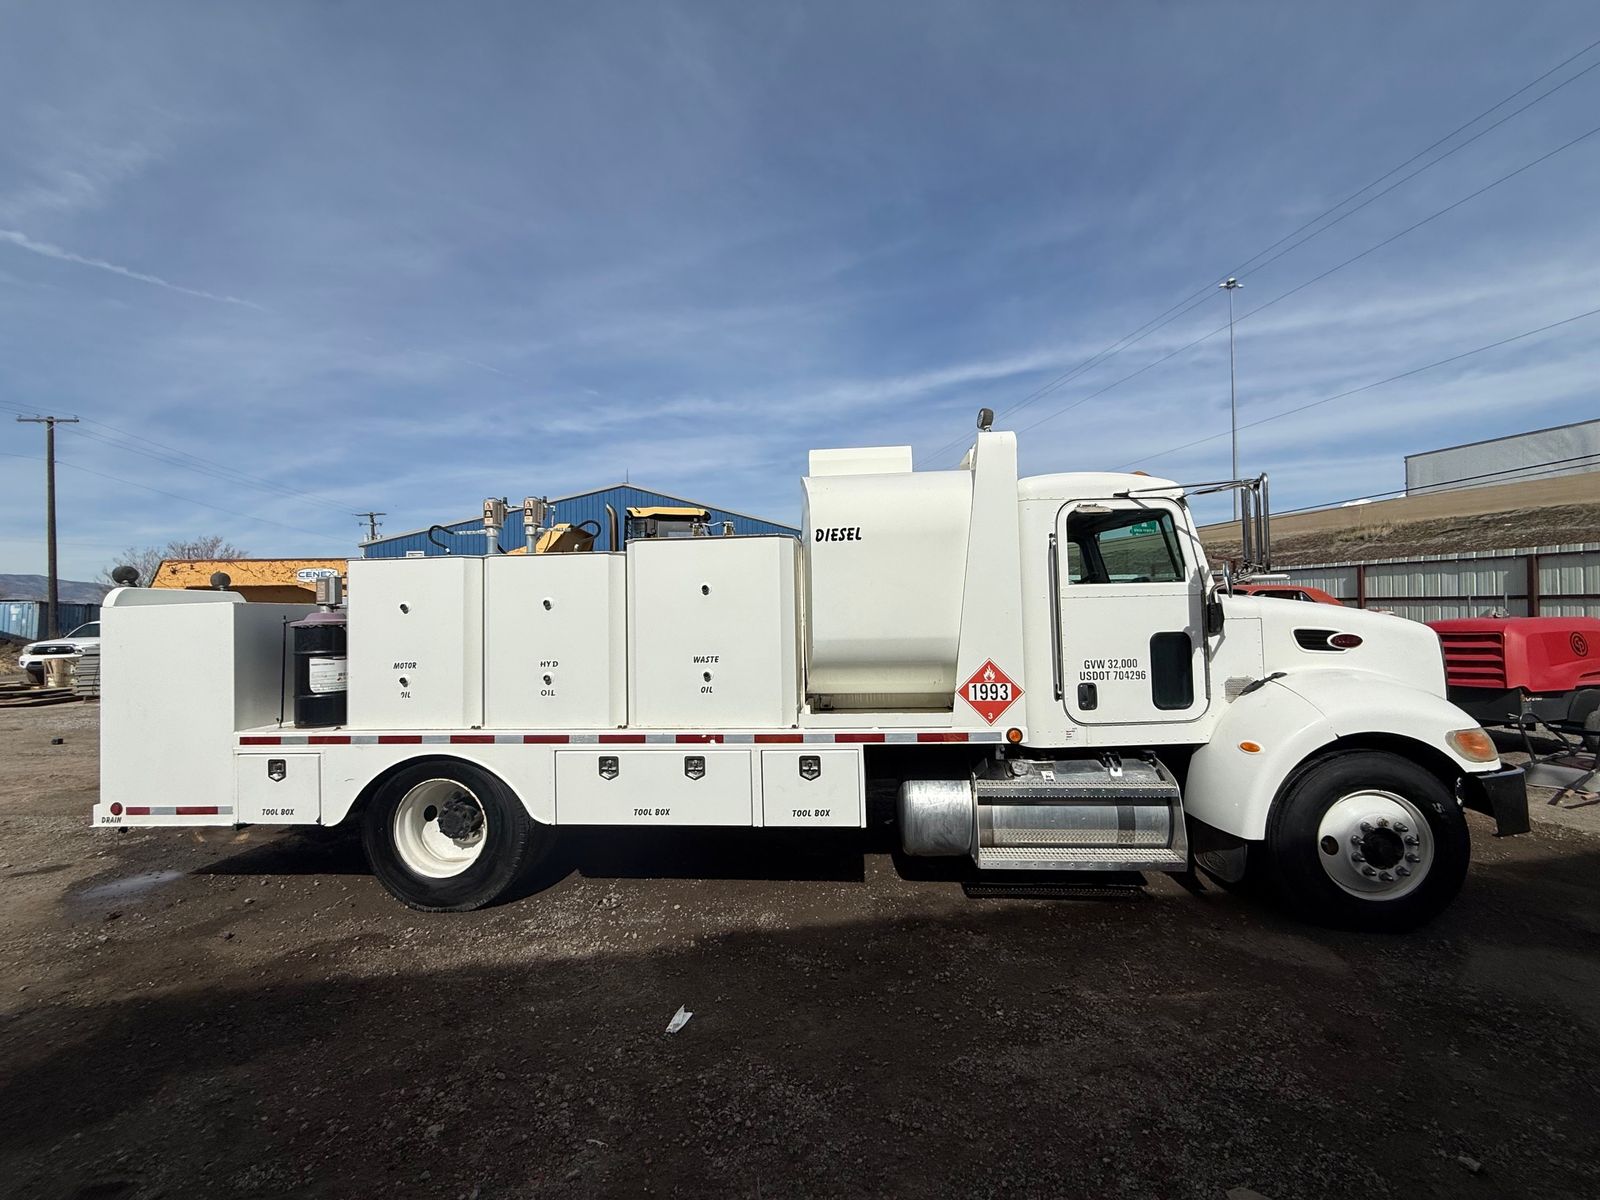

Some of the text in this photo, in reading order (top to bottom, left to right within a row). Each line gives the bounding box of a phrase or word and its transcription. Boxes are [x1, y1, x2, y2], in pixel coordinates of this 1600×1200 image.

[815, 527, 862, 542] DIESEL
[693, 655, 720, 664] WASTE
[392, 662, 417, 670] MOTOR
[540, 660, 559, 668] HYD
[1084, 658, 1138, 670] GVW 32,000
[1079, 670, 1146, 681] USDOT 704296
[540, 689, 556, 697] OIL
[700, 686, 713, 694] OIL
[971, 683, 1009, 701] 1993
[987, 712, 994, 720] 3
[262, 808, 295, 816] TOOL BOX
[633, 808, 670, 816] TOOL BOX
[792, 809, 830, 817] TOOL BOX
[101, 816, 122, 824] DRAIN
